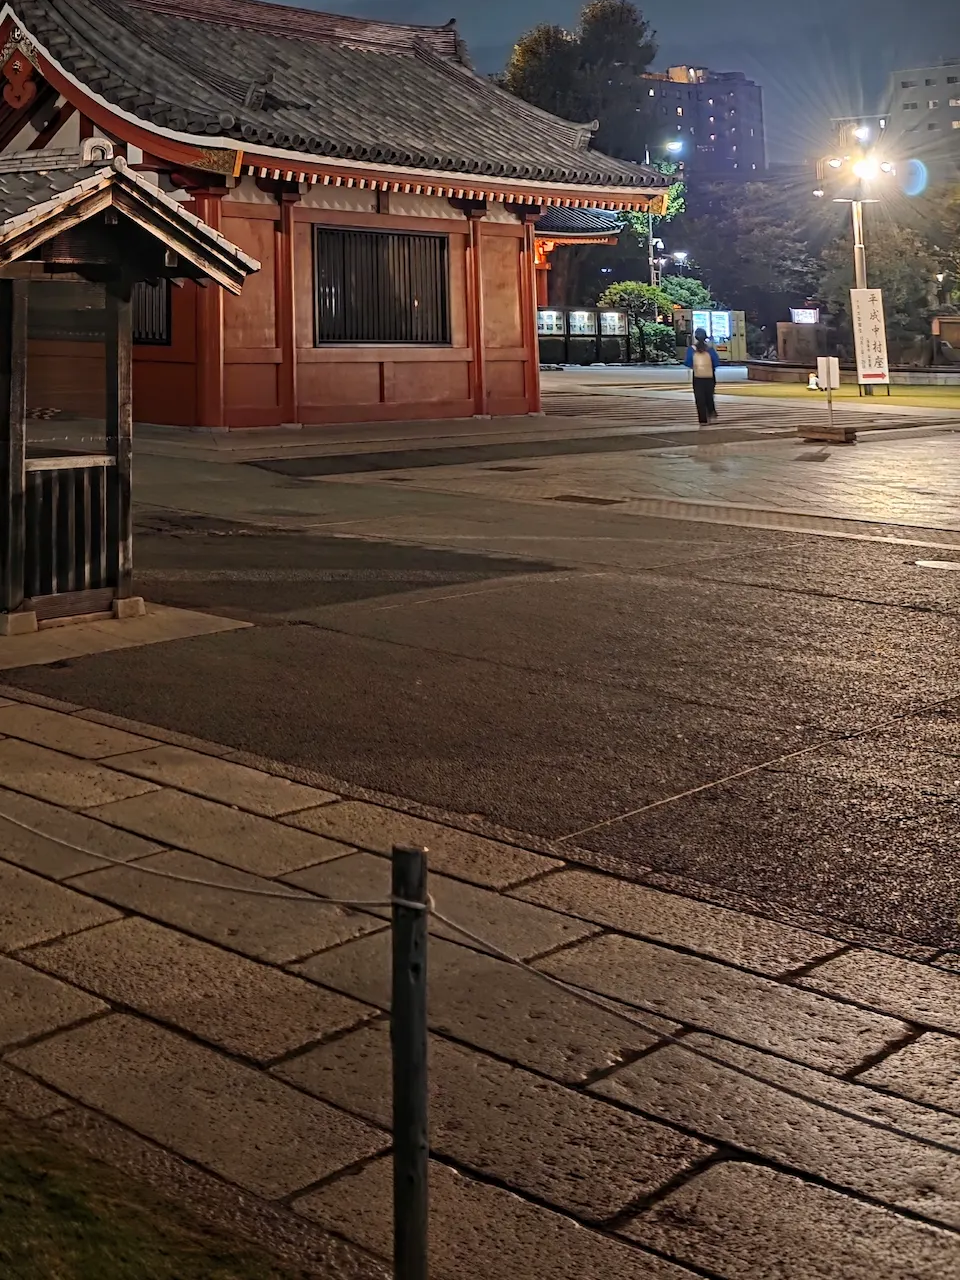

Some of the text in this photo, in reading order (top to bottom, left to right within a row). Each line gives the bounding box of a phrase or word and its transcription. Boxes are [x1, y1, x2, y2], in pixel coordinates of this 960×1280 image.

[868, 293, 884, 369] 平成中村座
